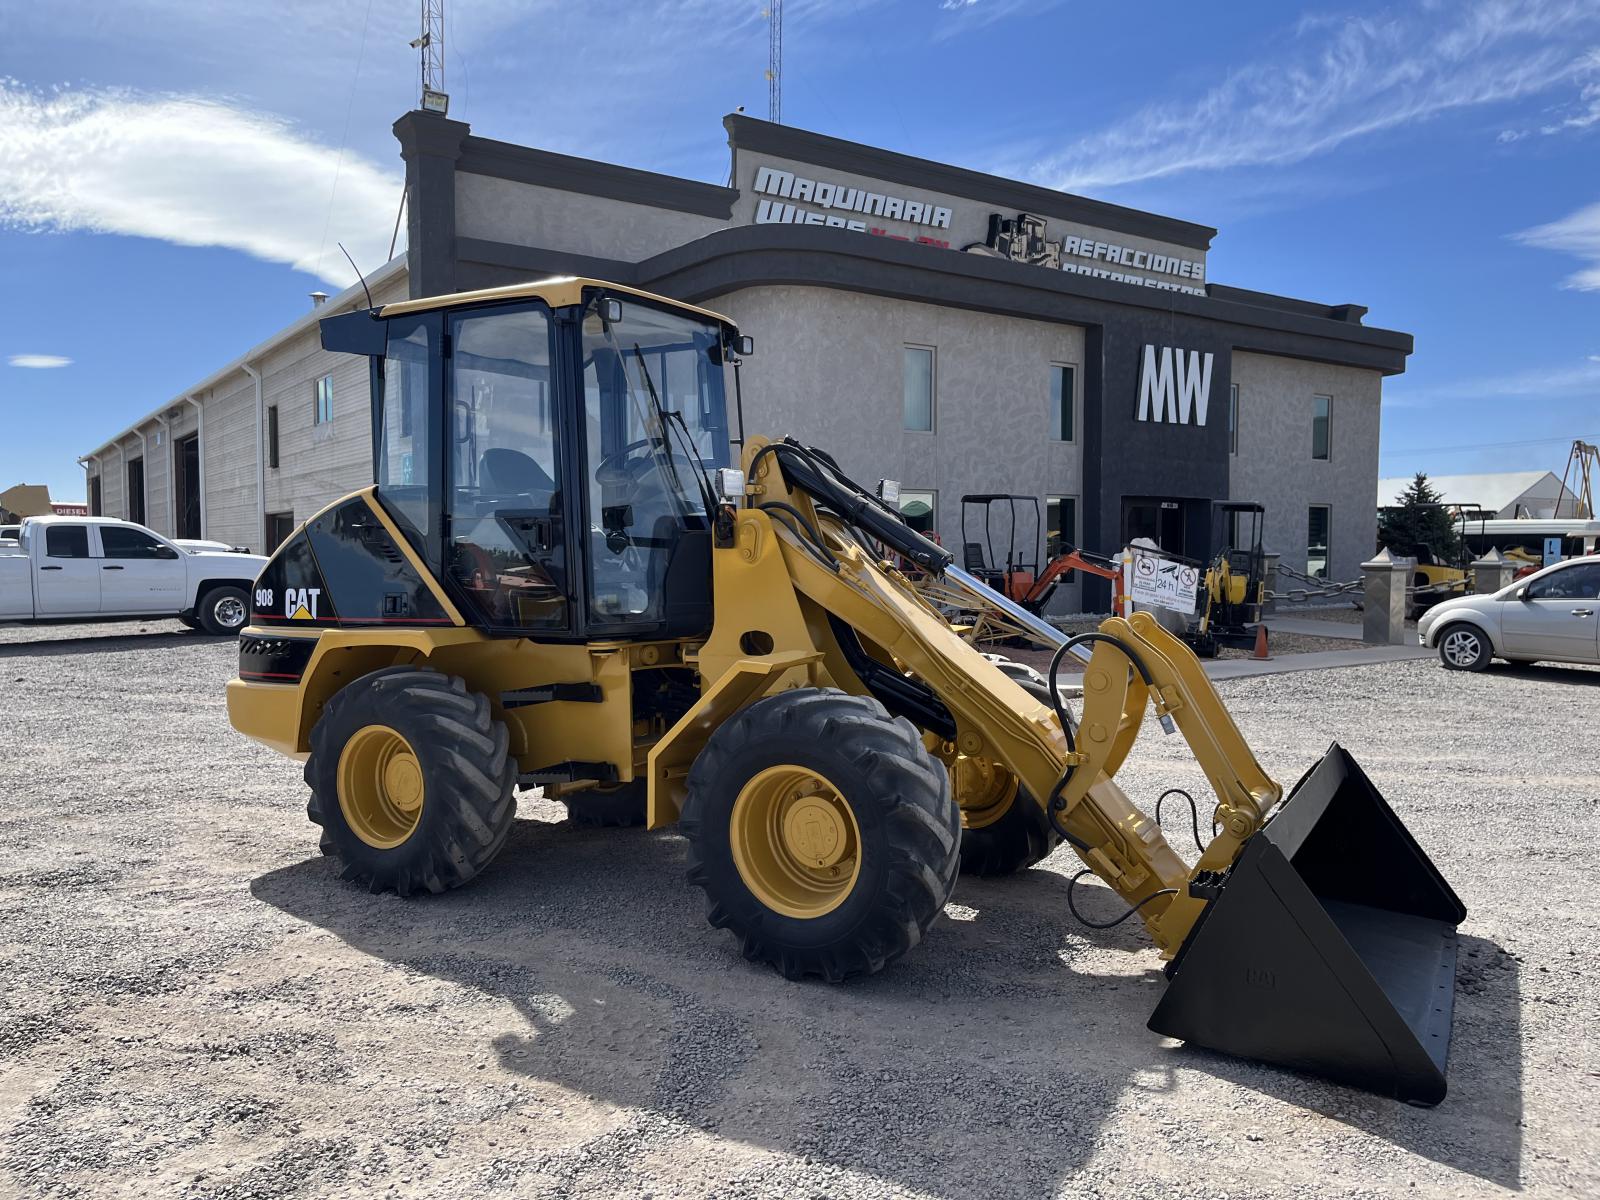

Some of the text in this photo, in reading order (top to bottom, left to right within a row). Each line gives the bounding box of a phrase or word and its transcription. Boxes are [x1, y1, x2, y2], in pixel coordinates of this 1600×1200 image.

[754, 166, 952, 229] MAQUINARIA
[1064, 235, 1205, 280] REFACCIONES
[1138, 344, 1214, 426] MW
[255, 588, 274, 607] 908
[1157, 578, 1167, 590] 24
[285, 588, 321, 620] CAT
